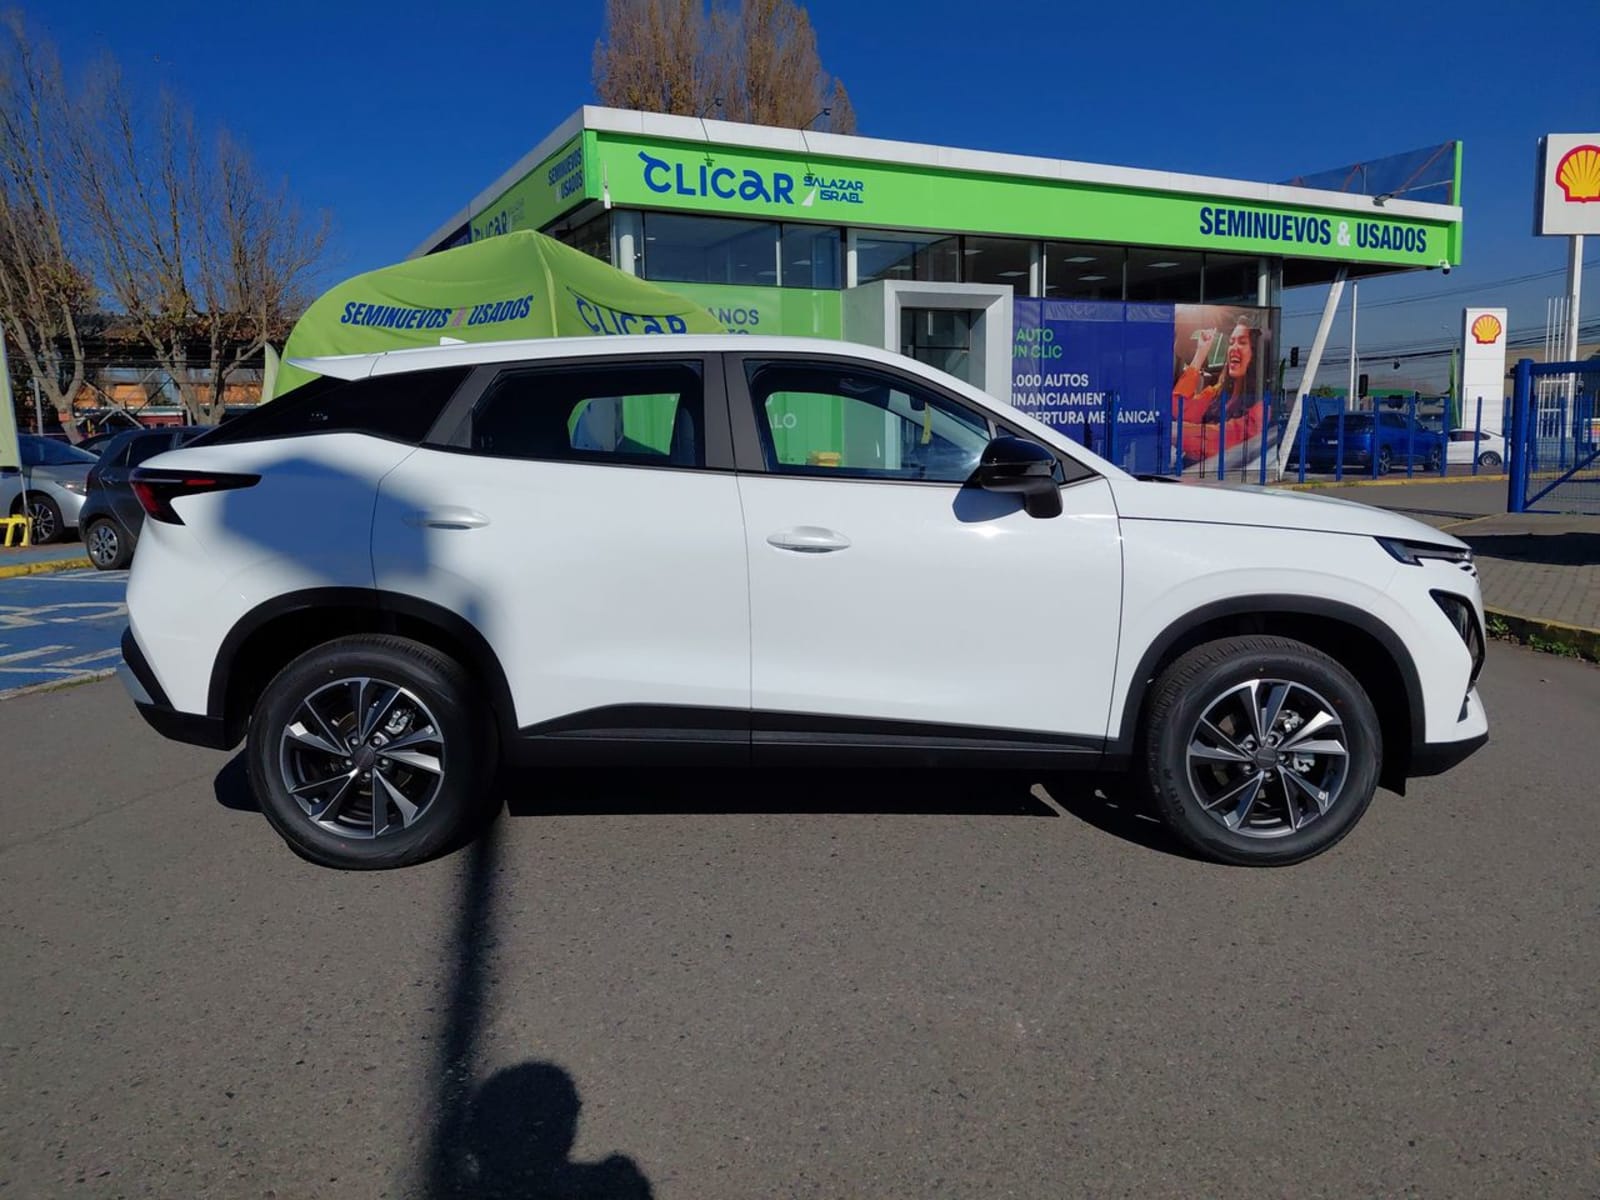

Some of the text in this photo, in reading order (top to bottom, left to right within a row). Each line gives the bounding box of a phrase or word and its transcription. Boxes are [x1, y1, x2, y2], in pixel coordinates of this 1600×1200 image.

[1199, 206, 1428, 253] SEMINUEVOS & USADOS
[340, 301, 453, 329] SEMINUEVOS
[466, 295, 534, 326] USADOS
[1016, 328, 1055, 343] AUTO
[1030, 344, 1064, 359] CLIC
[1012, 372, 1090, 388] .000 AUTOS
[1012, 391, 1120, 407] INANCIAMIEN
